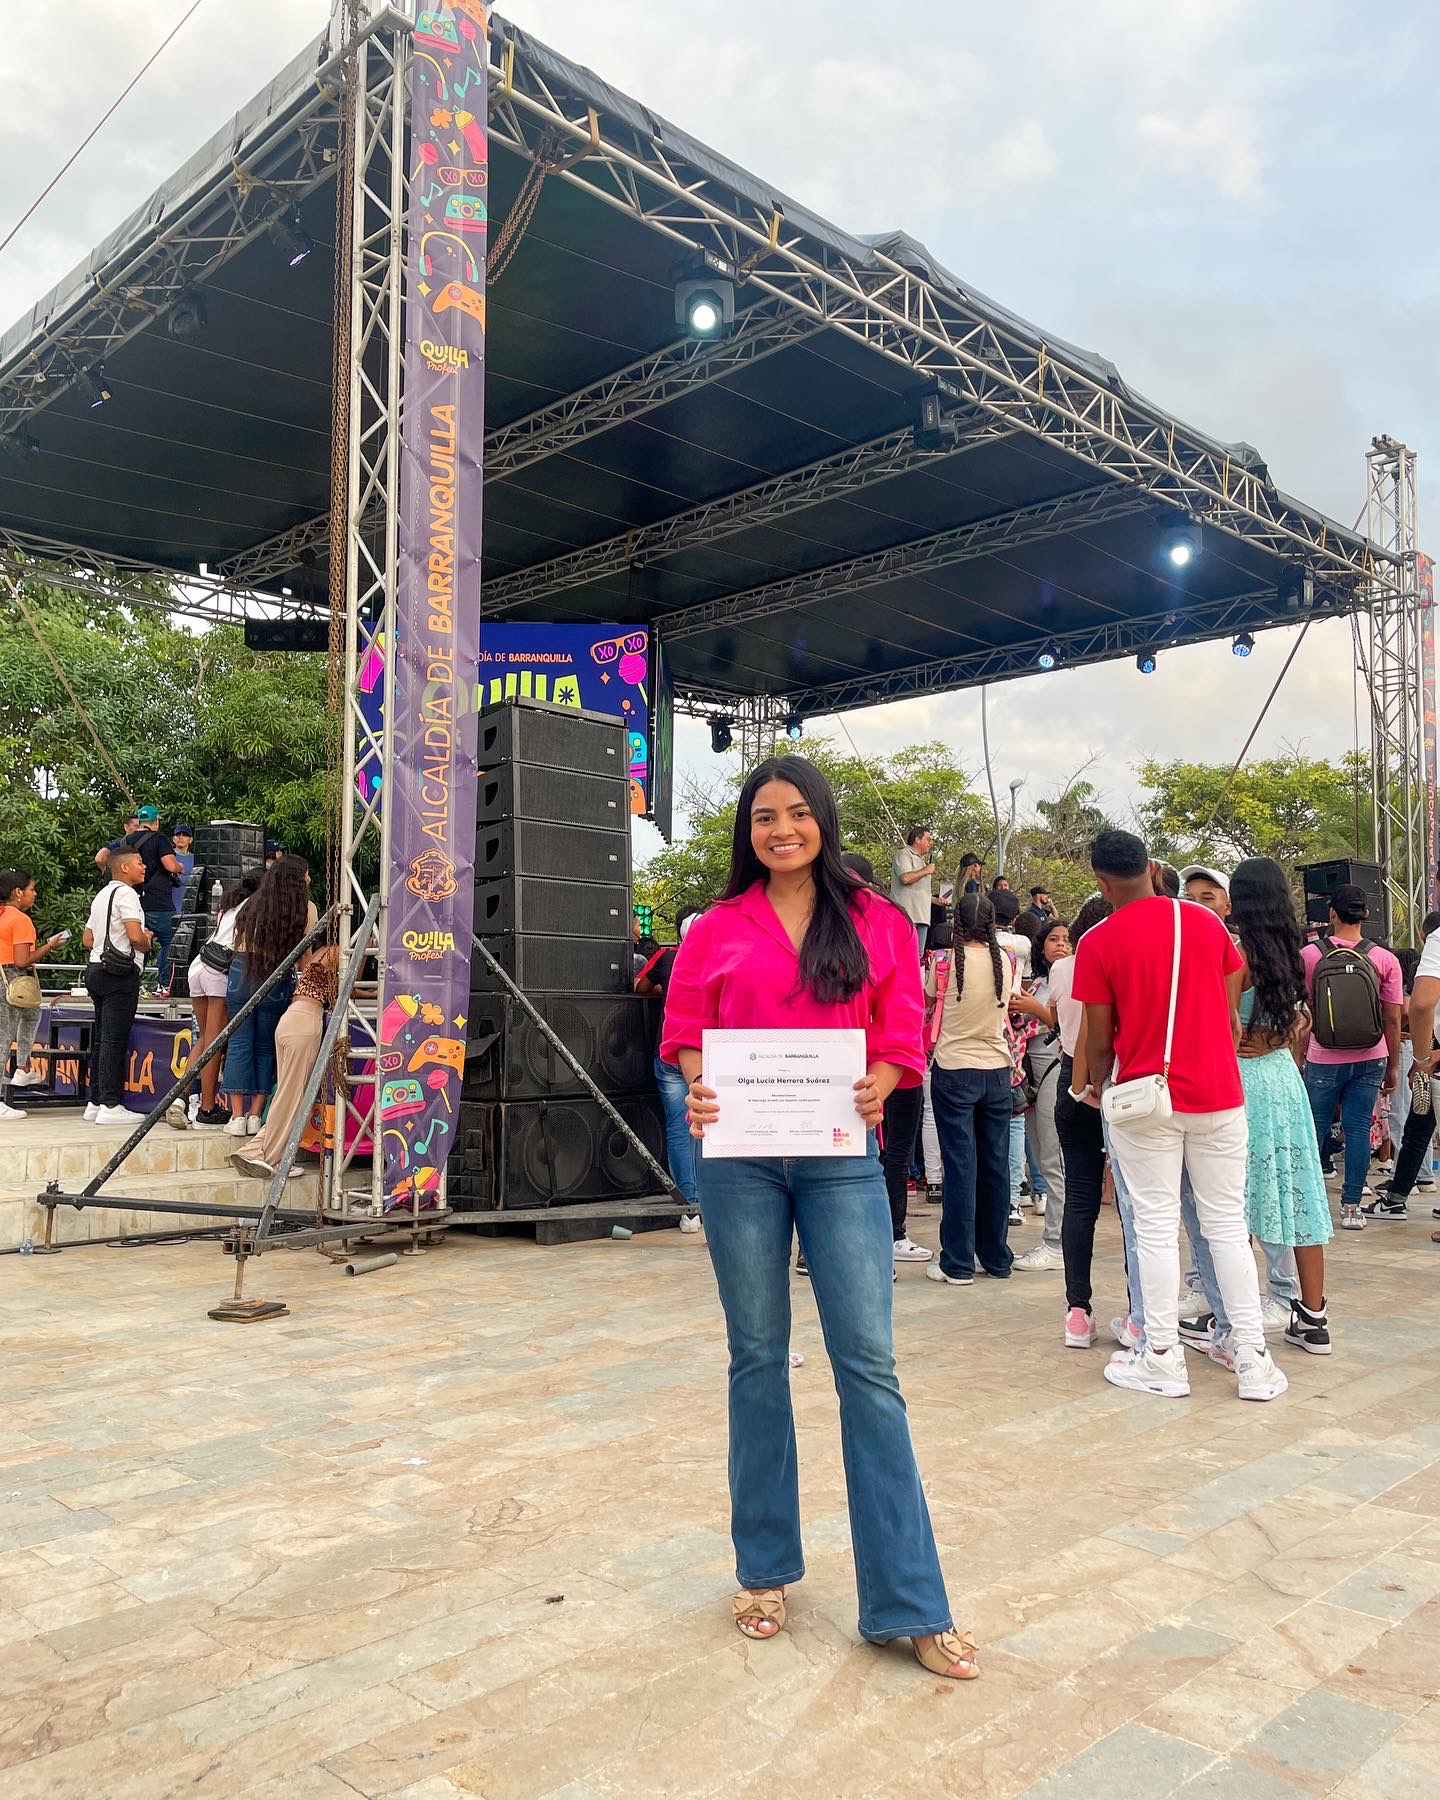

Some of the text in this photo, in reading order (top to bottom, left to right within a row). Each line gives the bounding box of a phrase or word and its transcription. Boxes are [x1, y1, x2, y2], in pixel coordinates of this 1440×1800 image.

[418, 404, 456, 842] ALCALDÍA DE BARRANQUILLA
[495, 653, 506, 662] DE
[508, 652, 573, 663] BARRANQUILLA
[738, 1077, 755, 1086] Olga
